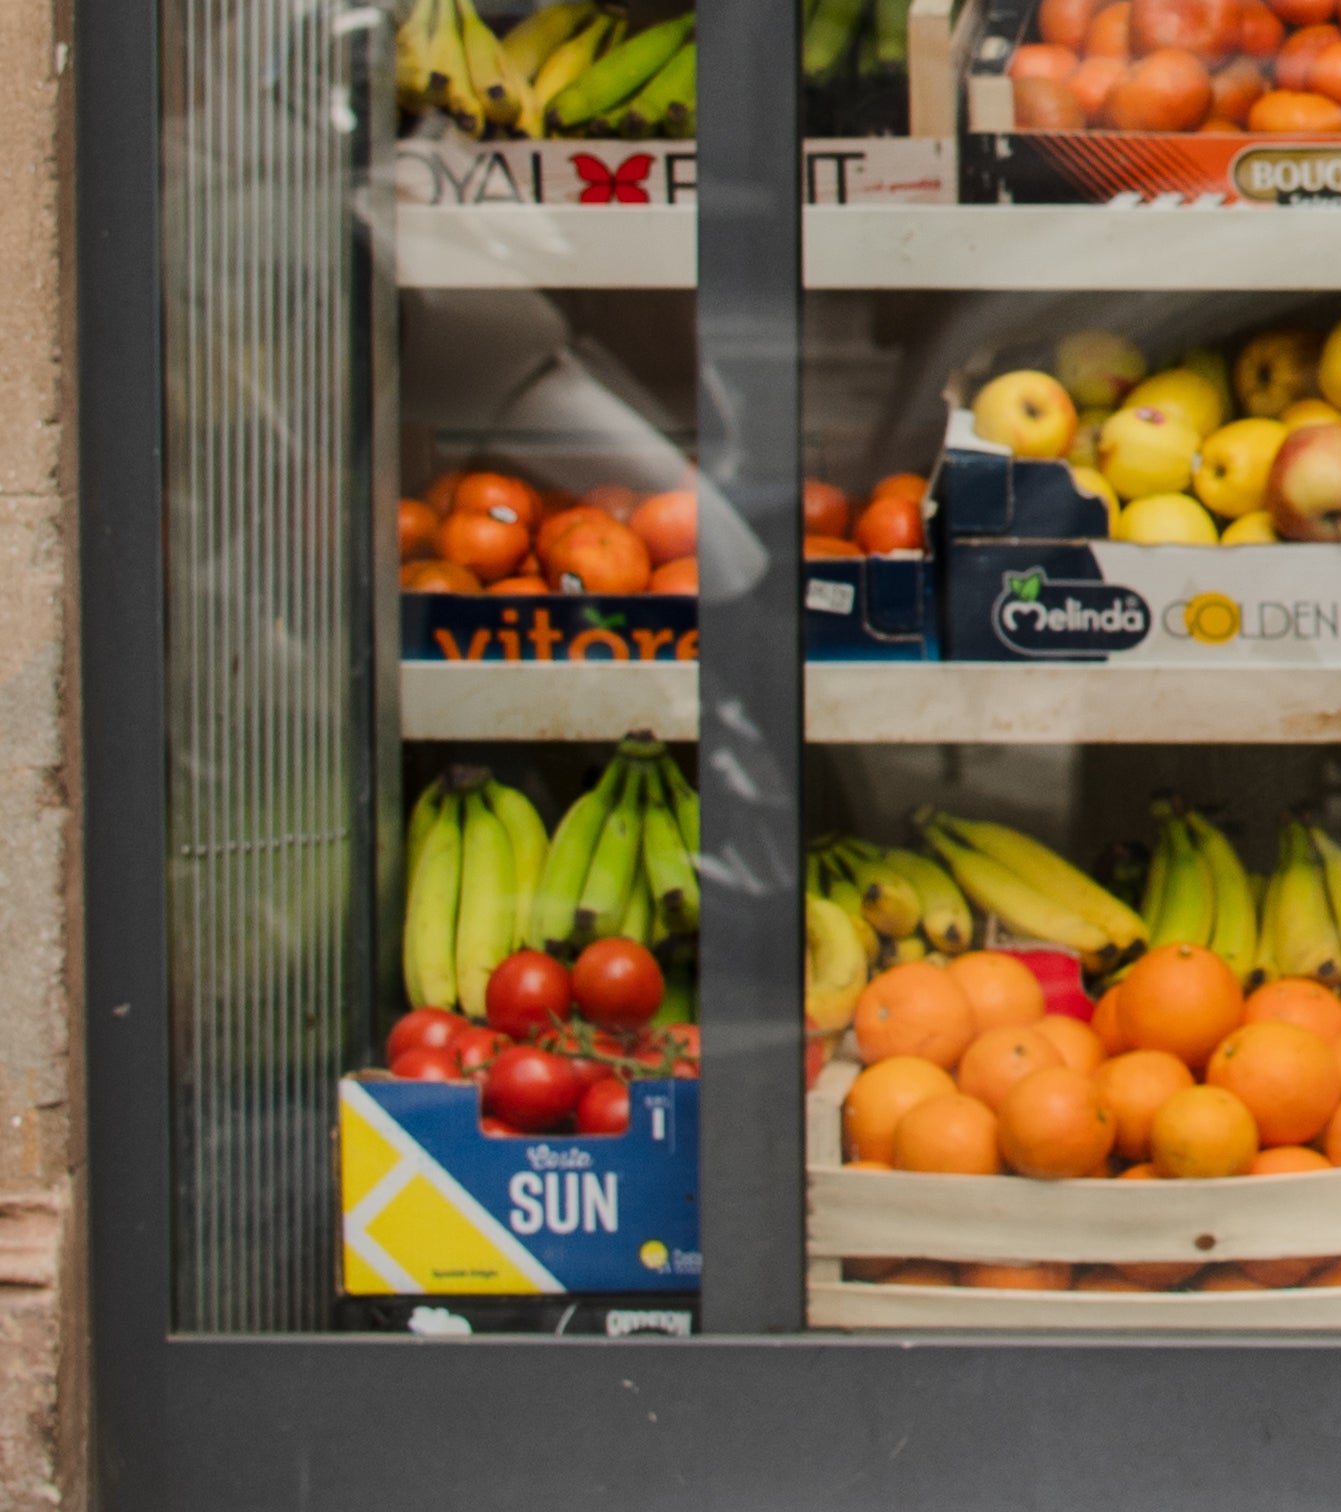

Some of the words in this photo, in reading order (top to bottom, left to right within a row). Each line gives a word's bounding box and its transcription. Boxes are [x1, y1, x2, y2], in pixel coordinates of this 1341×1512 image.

[1001, 596, 1146, 636] Melinda
[1162, 600, 1339, 640] GOLDEN
[509, 1171, 619, 1235] SUN
